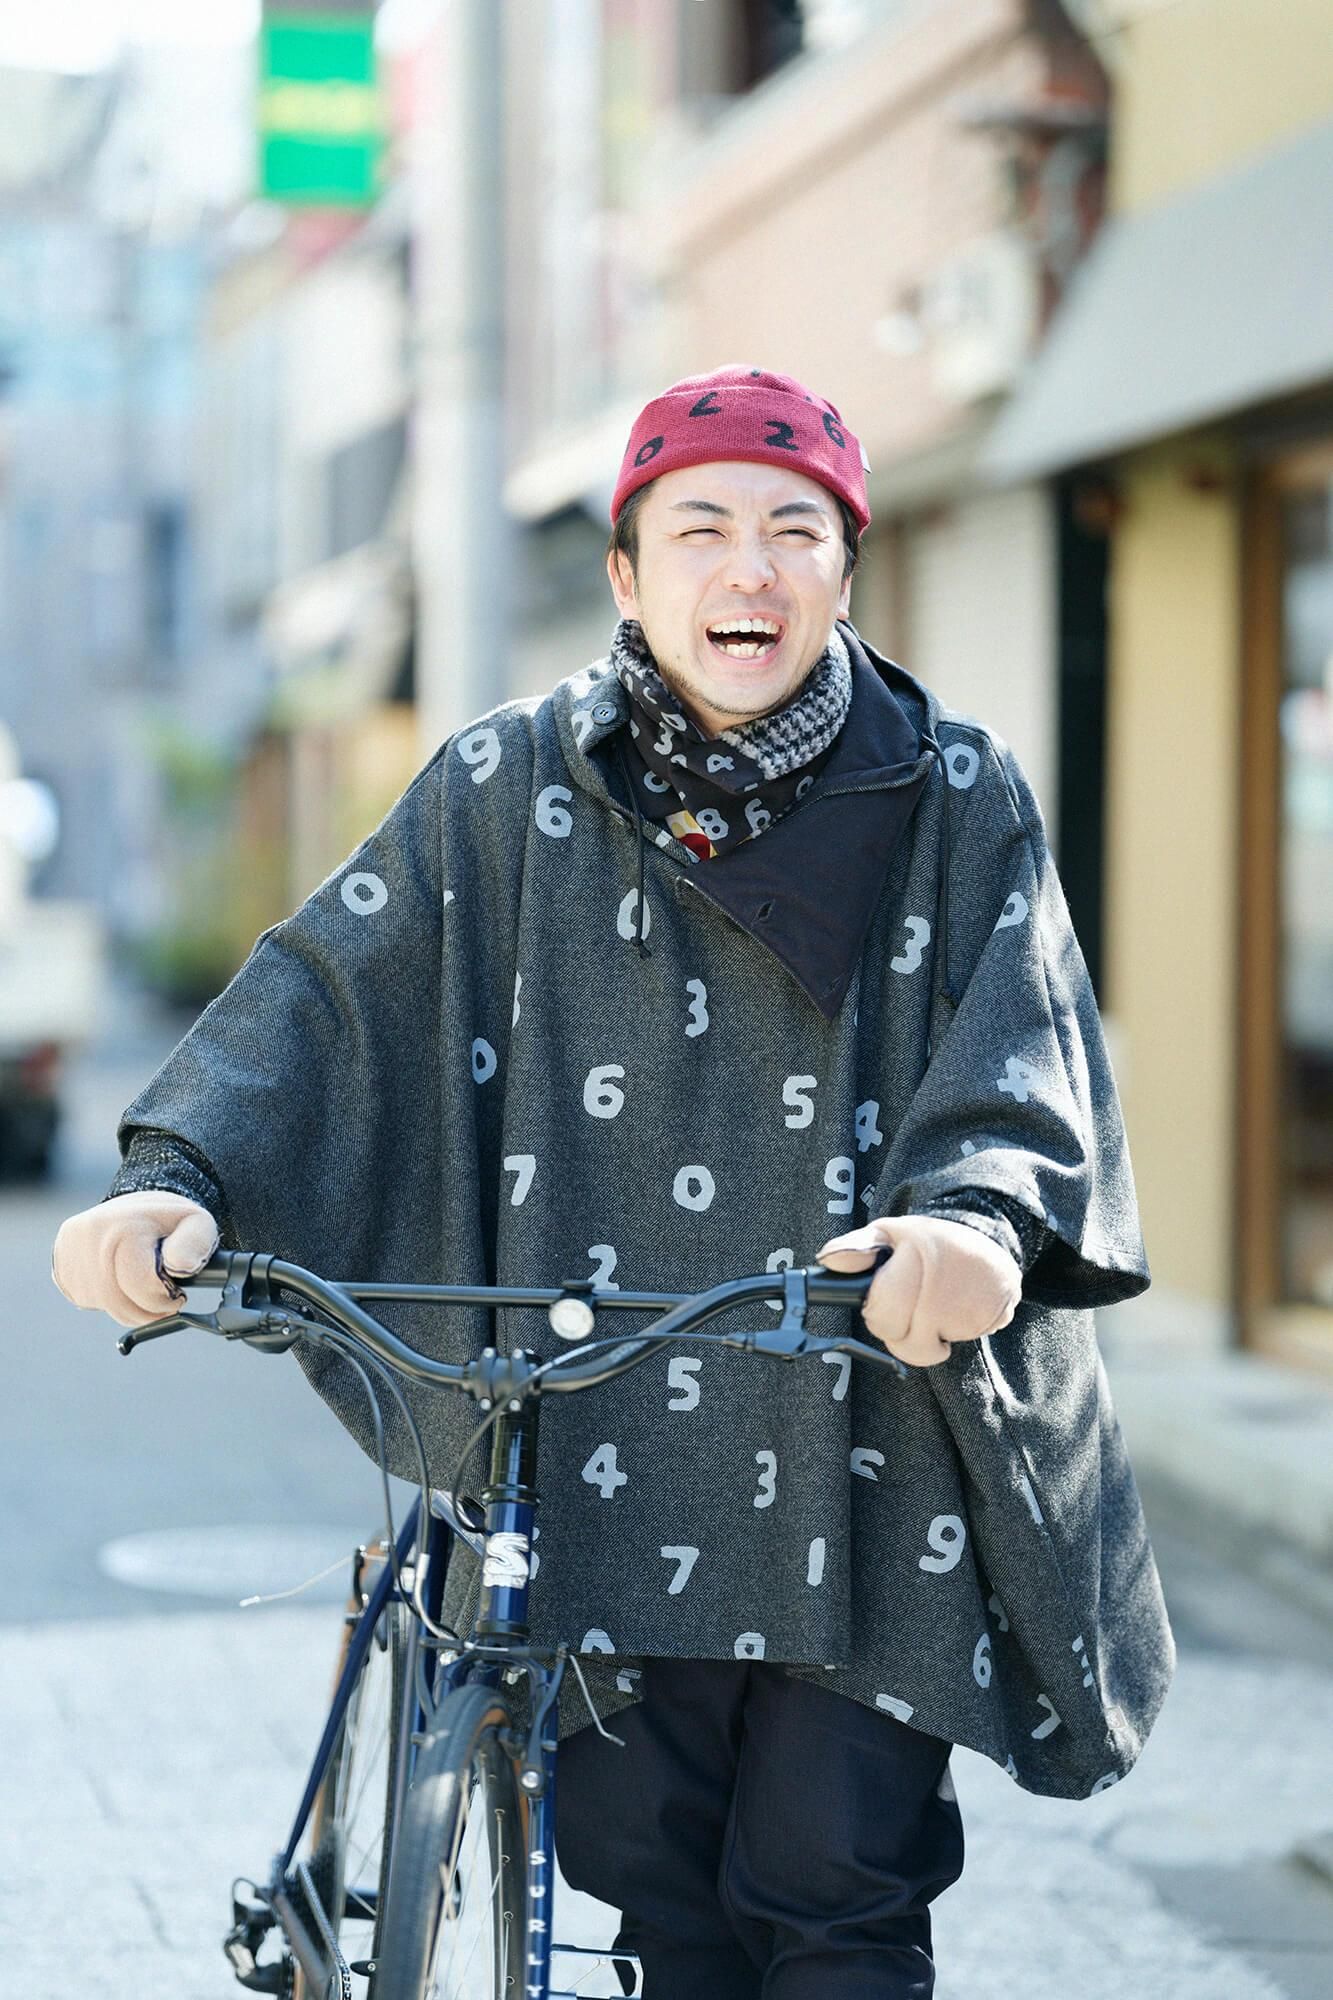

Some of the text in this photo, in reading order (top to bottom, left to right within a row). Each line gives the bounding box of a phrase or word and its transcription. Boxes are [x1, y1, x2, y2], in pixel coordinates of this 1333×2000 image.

[634, 426, 664, 466] 0
[764, 420, 799, 451] 2
[457, 728, 501, 784] 9
[706, 753, 736, 774] 4
[938, 742, 980, 789] 0
[535, 785, 574, 838] 6
[696, 808, 729, 841] 8
[340, 872, 388, 915] 0
[890, 915, 931, 974] 3
[685, 978, 709, 1037] 3
[471, 1037, 497, 1084] 0
[583, 1064, 625, 1119] 6
[782, 1075, 817, 1129] 5
[855, 1100, 883, 1152] 4
[503, 1154, 536, 1206] 7
[673, 1165, 715, 1212] 0
[668, 1357, 702, 1411] 5
[822, 1352, 851, 1400] 7
[581, 1443, 627, 1498] 4
[754, 1450, 777, 1509] 3
[807, 1537, 825, 1586] 1
[919, 1514, 966, 1573] 9
[660, 1545, 700, 1595] 7
[973, 1632, 992, 1689] 6
[526, 1850, 547, 1998] SURLY
